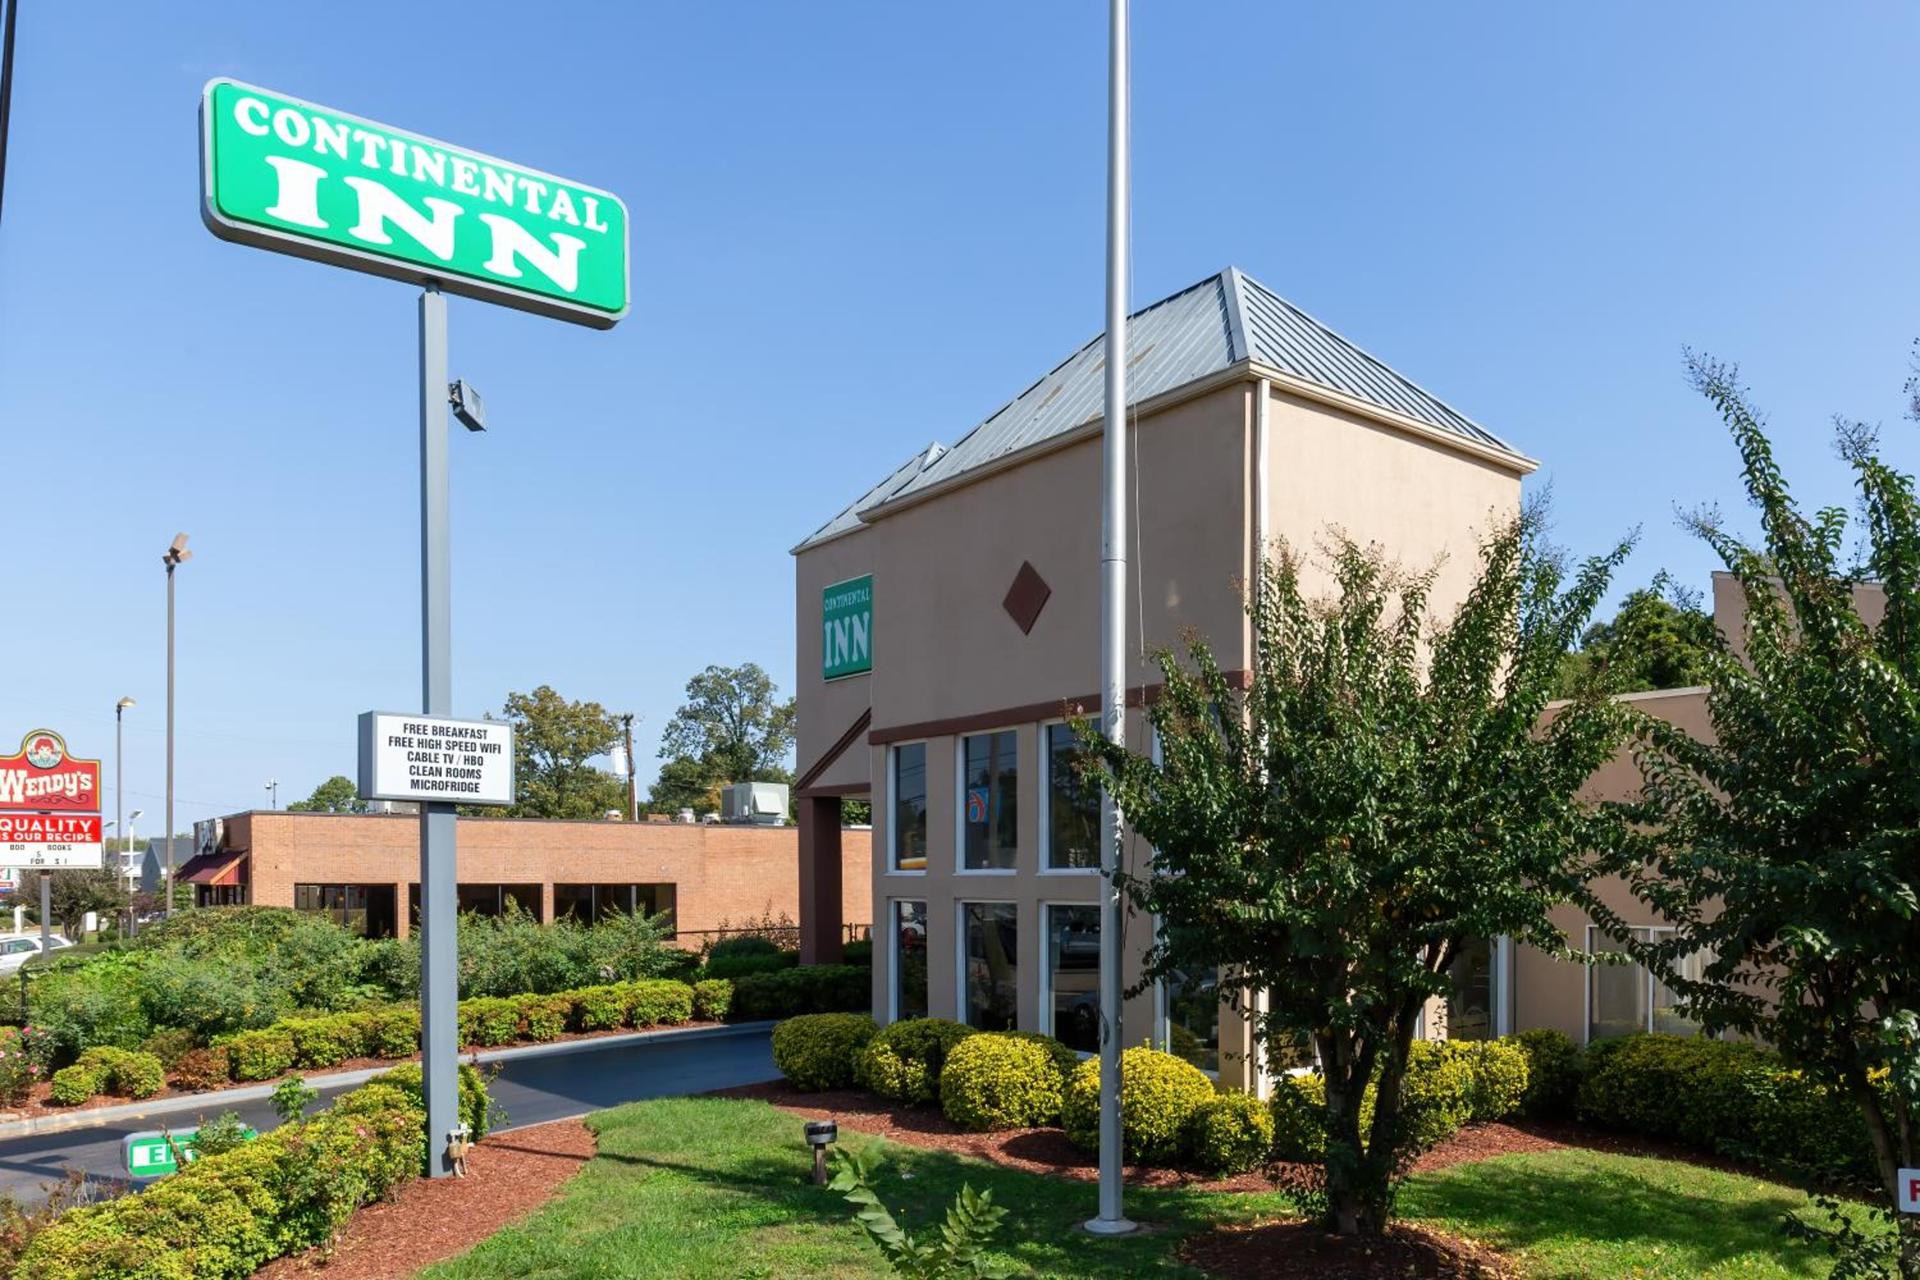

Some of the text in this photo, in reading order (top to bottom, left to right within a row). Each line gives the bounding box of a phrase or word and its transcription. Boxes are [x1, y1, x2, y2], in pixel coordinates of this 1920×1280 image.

[234, 96, 608, 234] CONTINENTAL
[265, 155, 587, 293] INN
[825, 587, 870, 611] CONTINENTAL
[824, 611, 870, 668] INN
[403, 723, 488, 740] FREE BREAKFAST
[388, 736, 501, 755] FREE HIGH SPEED WIFI
[407, 751, 440, 764] CABLE
[443, 753, 455, 765] TV
[463, 755, 484, 767] HBO
[409, 765, 482, 779] CLEAN ROOMS
[410, 779, 480, 793] MICROFRIDGE
[0, 818, 92, 832] QUALITY
[13, 832, 42, 841] OUR
[46, 833, 93, 842] RECIPE
